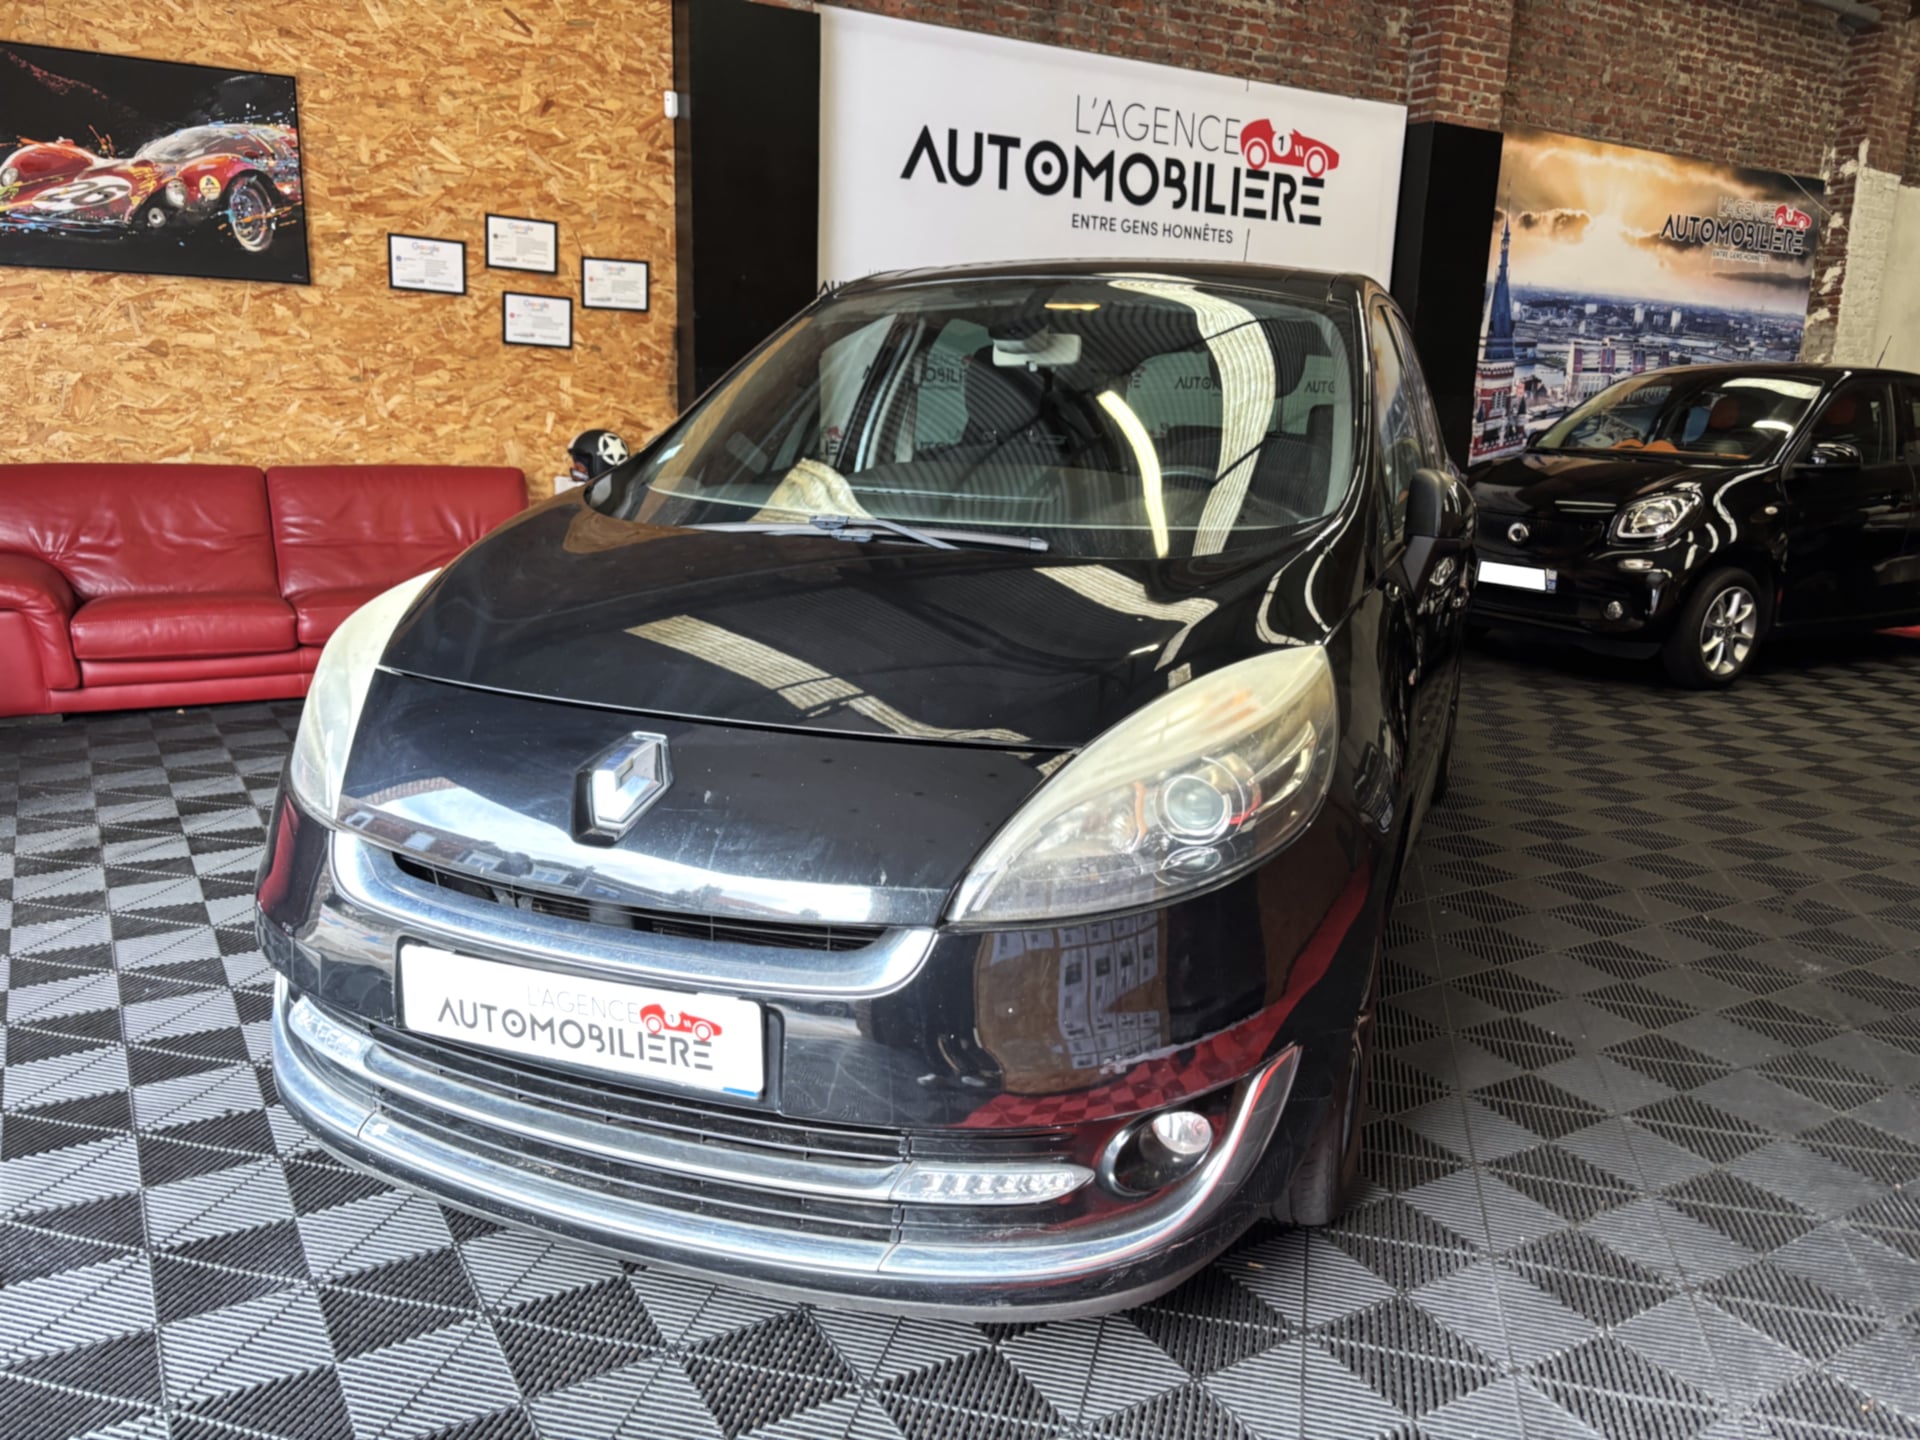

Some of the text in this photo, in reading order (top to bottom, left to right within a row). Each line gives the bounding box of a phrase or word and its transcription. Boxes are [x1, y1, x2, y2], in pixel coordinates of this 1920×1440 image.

[1075, 94, 1241, 156] L'AGENCE
[1277, 134, 1286, 151] 1
[34, 181, 131, 206] 26
[900, 124, 1325, 226] AUTOMOBILIERE
[1071, 213, 1234, 244] ENTRE GENS HONNÊTES
[1717, 196, 1777, 224] L'AGENCE
[1660, 213, 1806, 254] AUTOMOBILIERE
[526, 984, 641, 1025] L'AGENCE
[437, 997, 714, 1071] AUTOMOBILIERE
